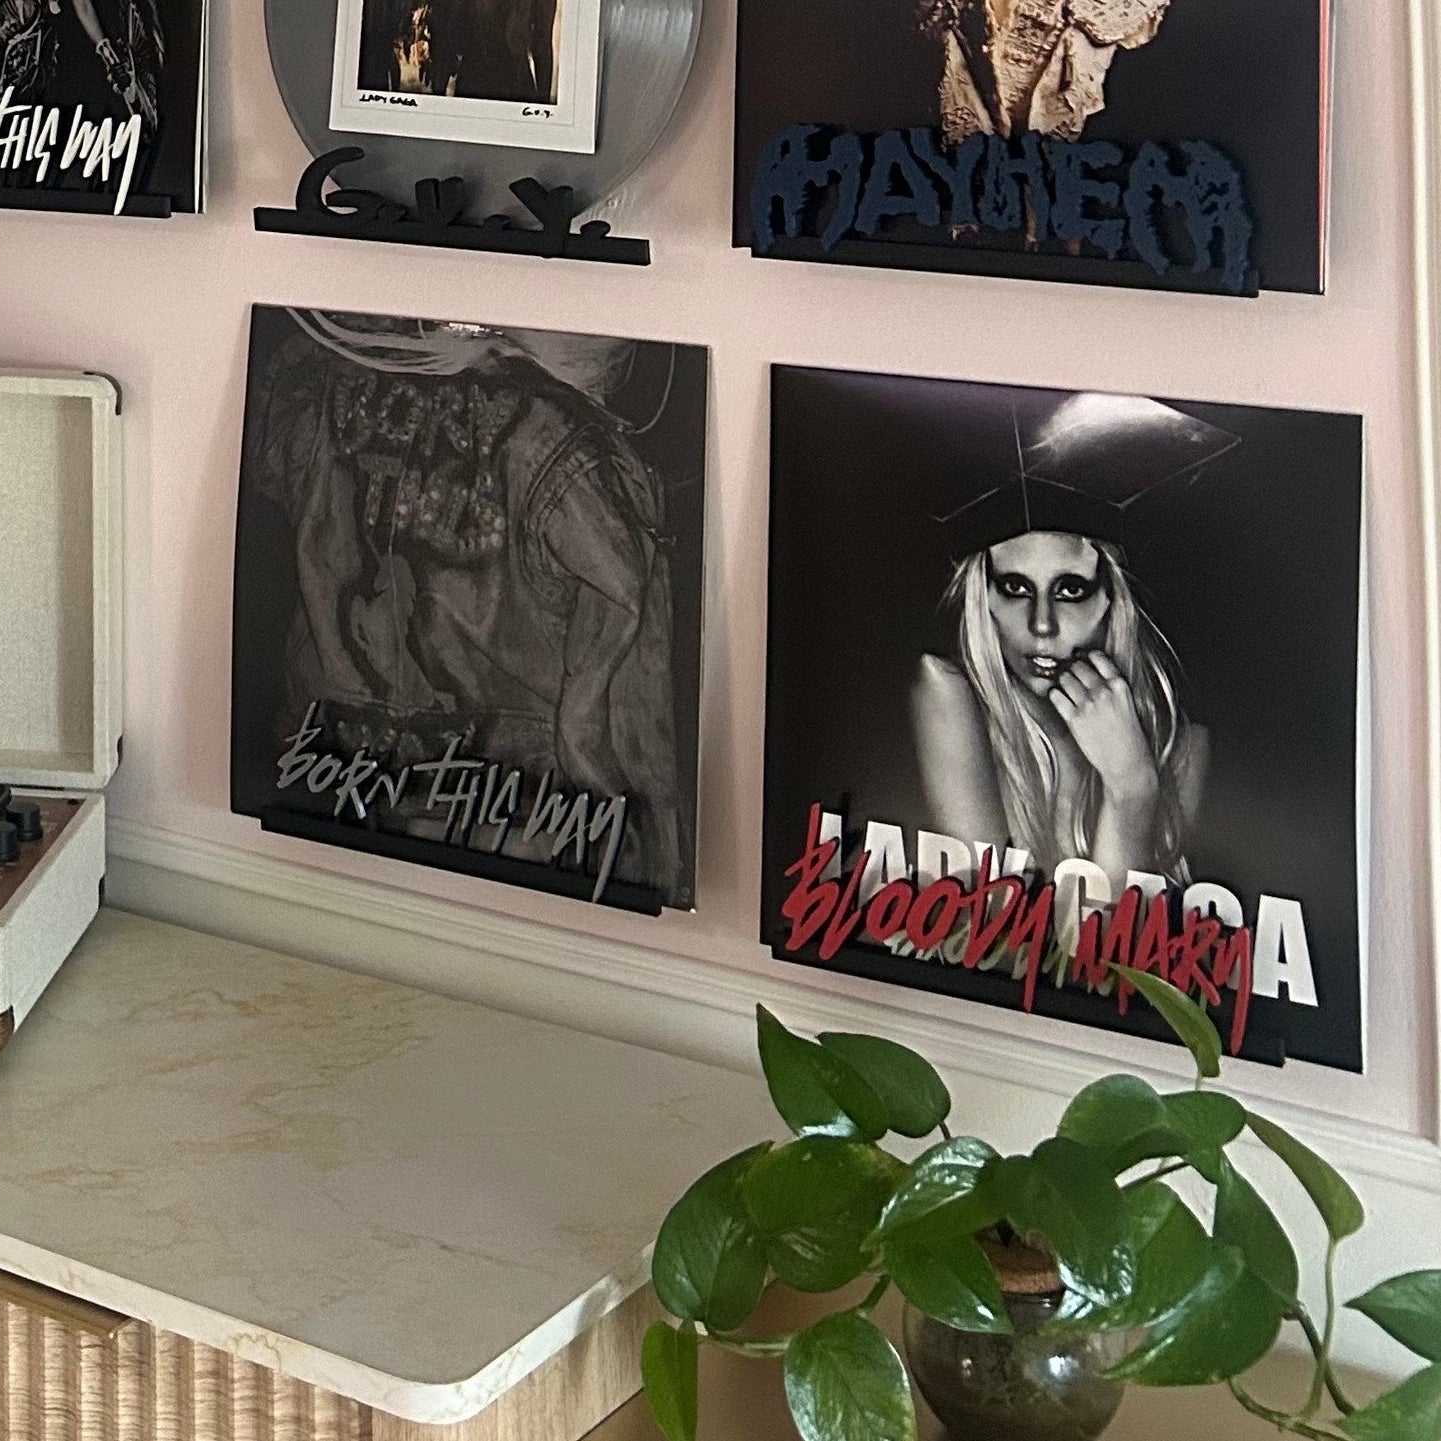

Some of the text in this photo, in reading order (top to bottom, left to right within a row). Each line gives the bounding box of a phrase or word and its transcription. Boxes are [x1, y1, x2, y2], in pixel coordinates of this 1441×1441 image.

[359, 93, 418, 107] LADY GAGA
[751, 124, 1251, 286] MAYHEM
